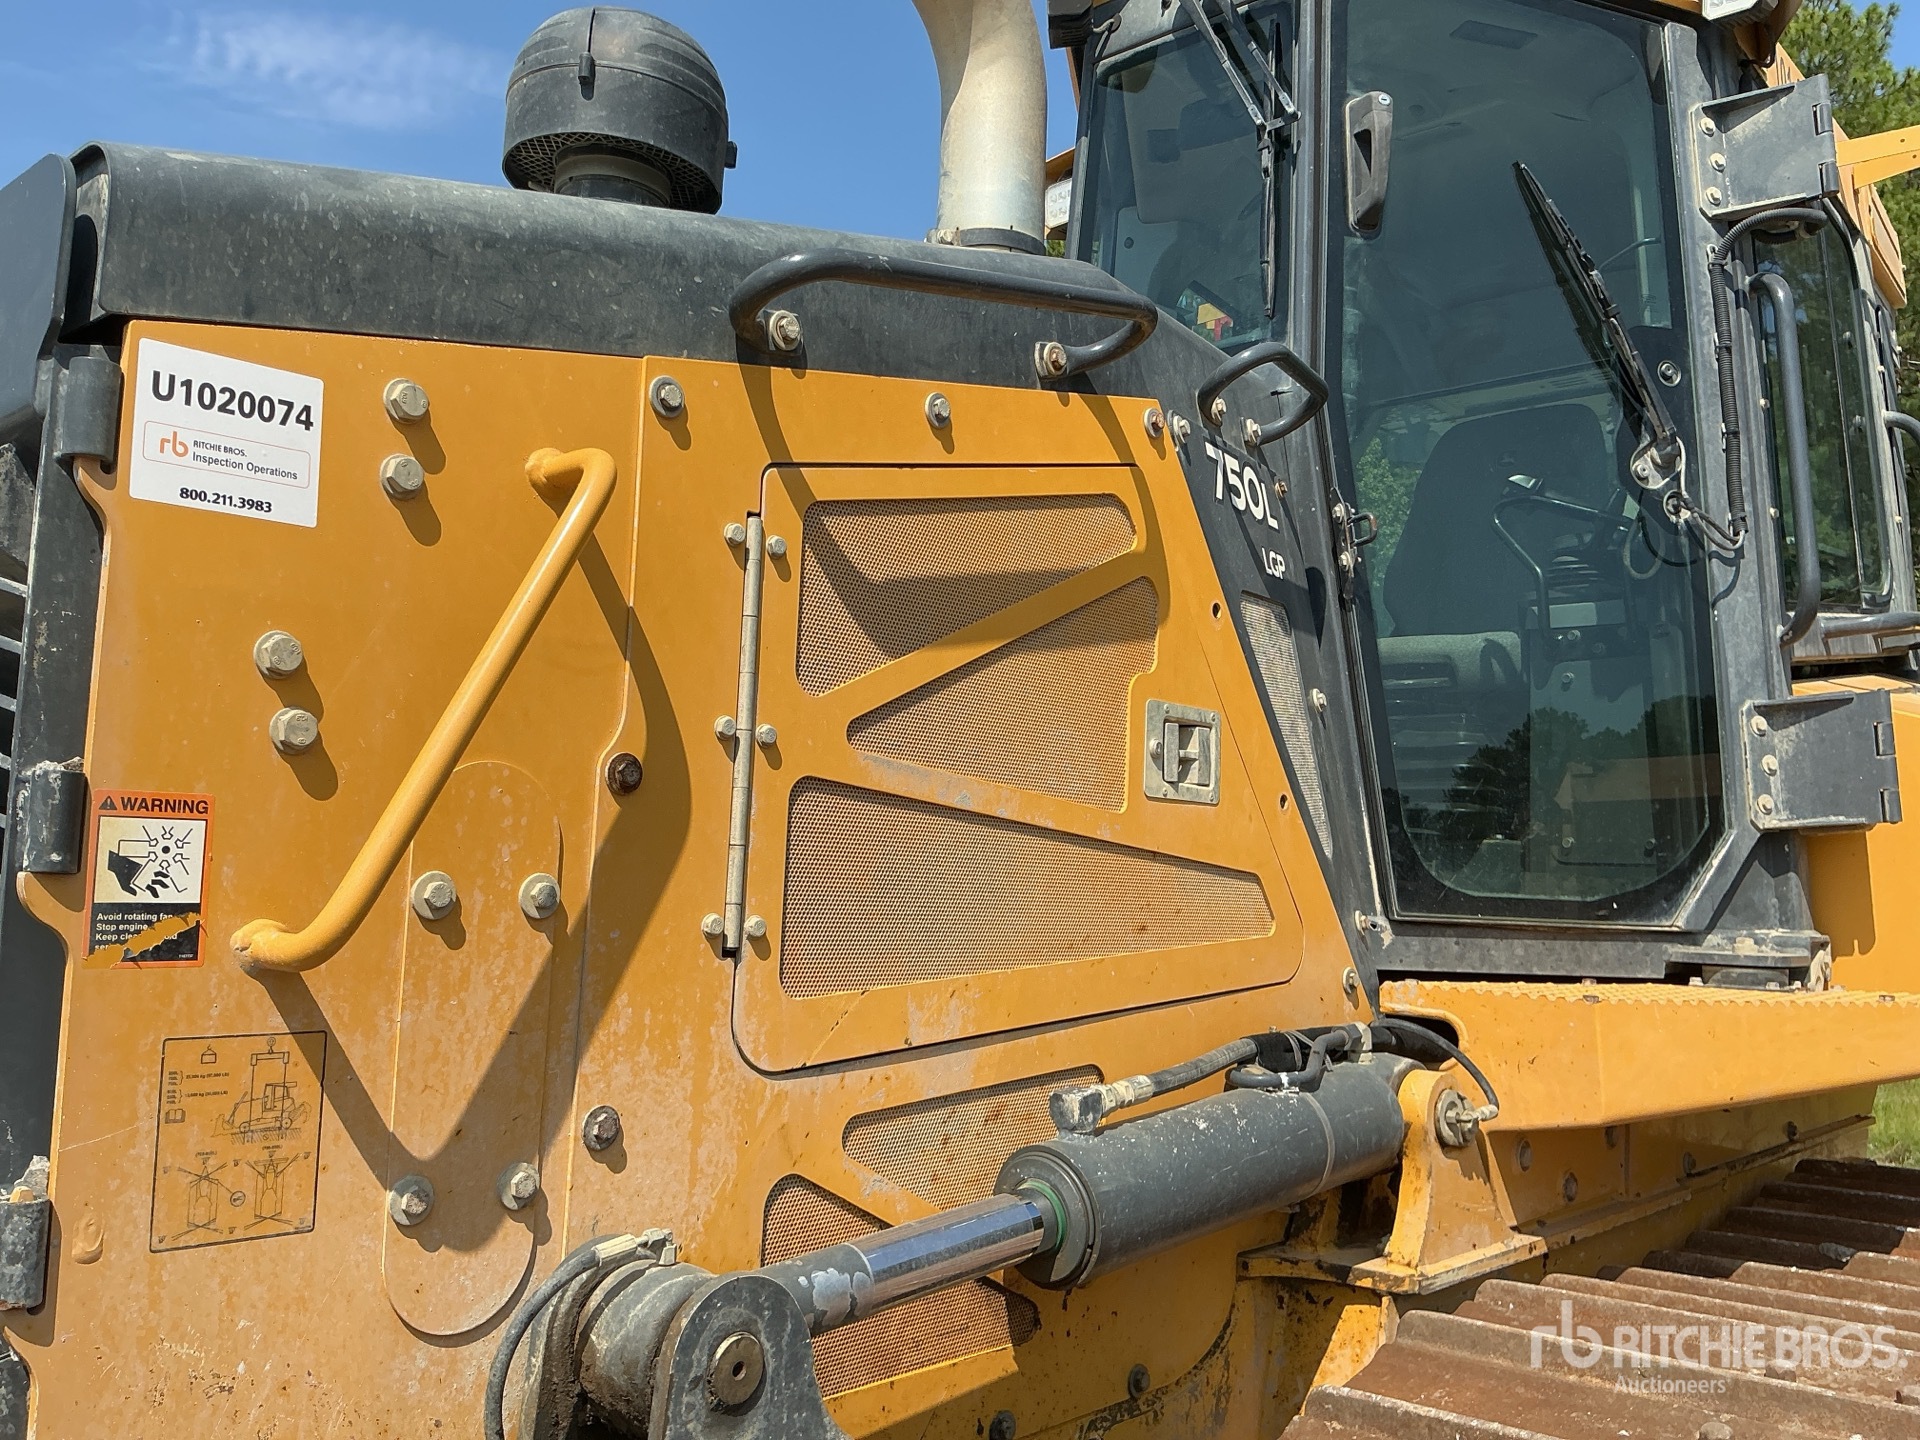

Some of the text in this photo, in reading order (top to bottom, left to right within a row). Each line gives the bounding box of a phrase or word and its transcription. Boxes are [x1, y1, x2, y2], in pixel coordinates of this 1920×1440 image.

[151, 370, 314, 431] U1020074
[159, 431, 189, 458] rb
[193, 440, 248, 458] RITCHIE BROS.
[192, 452, 298, 480] Inspection Operations
[1205, 441, 1279, 530] 750L
[179, 487, 273, 513] 800.211.3983
[1261, 547, 1286, 580] LGP
[120, 796, 209, 815] WARNING
[96, 913, 122, 921] Avoid
[124, 913, 158, 922] rotating
[96, 923, 148, 932] Stop engine
[95, 933, 118, 941] Keep
